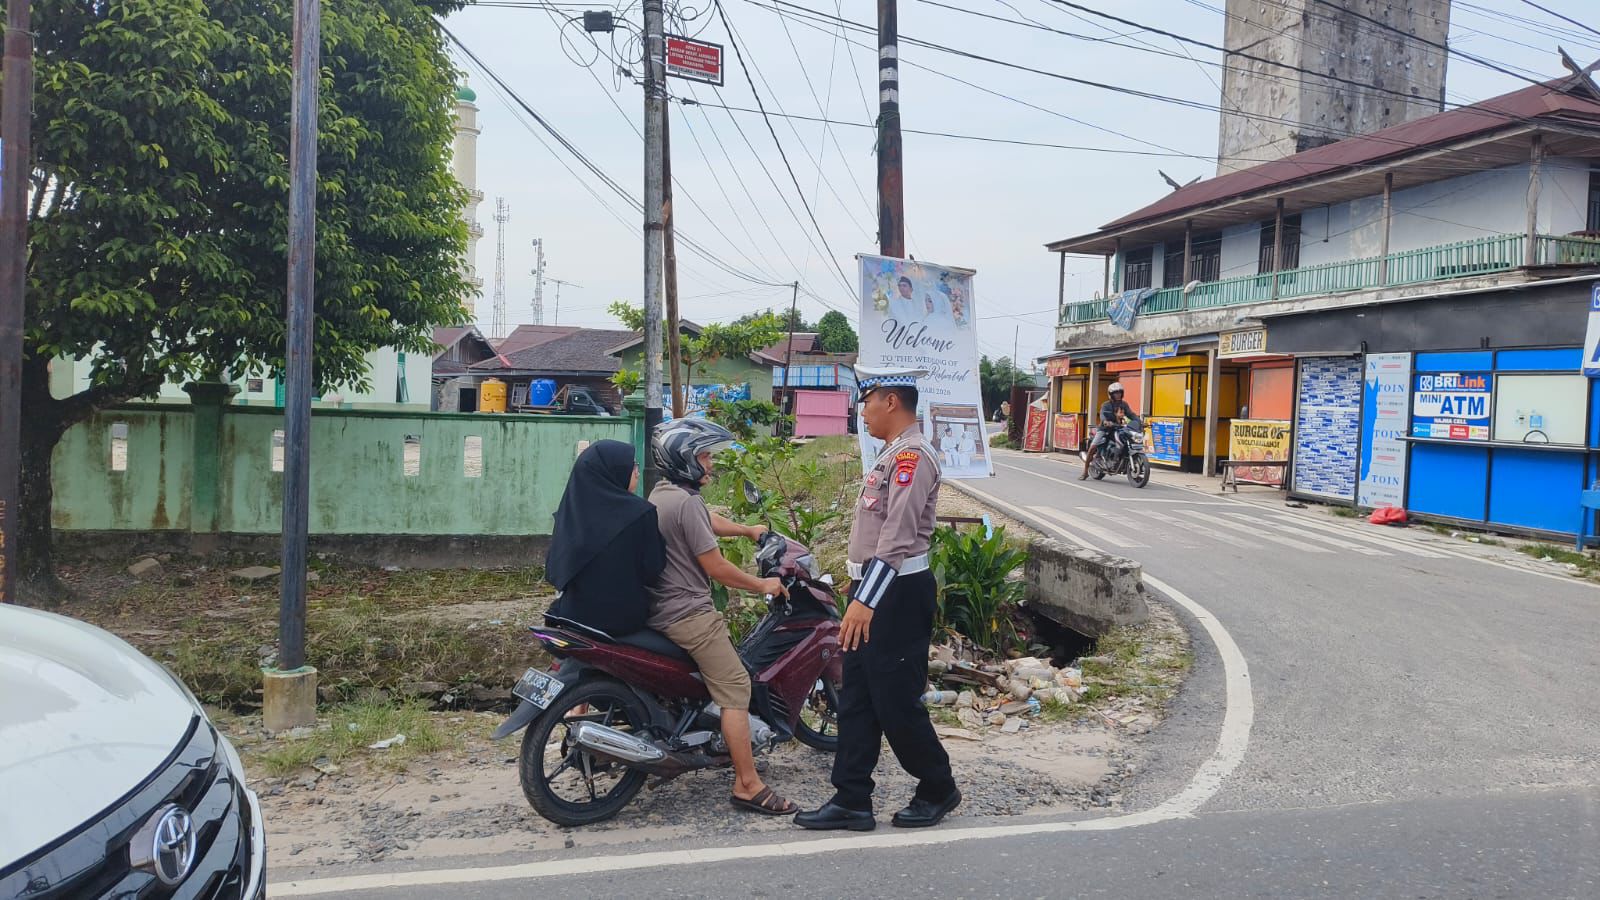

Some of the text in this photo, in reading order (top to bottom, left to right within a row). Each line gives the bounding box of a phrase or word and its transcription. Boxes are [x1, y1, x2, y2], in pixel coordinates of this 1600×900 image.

[881, 319, 955, 352] Welcome
[1231, 332, 1263, 351] BURGER
[895, 355, 913, 363] THE
[914, 356, 946, 366] WEDDING
[947, 359, 958, 367] OF
[1434, 376, 1486, 388] BRILink
[1420, 394, 1485, 416] MINI ATM
[1234, 425, 1269, 439] BURGER
[1372, 474, 1400, 486] TOIN
